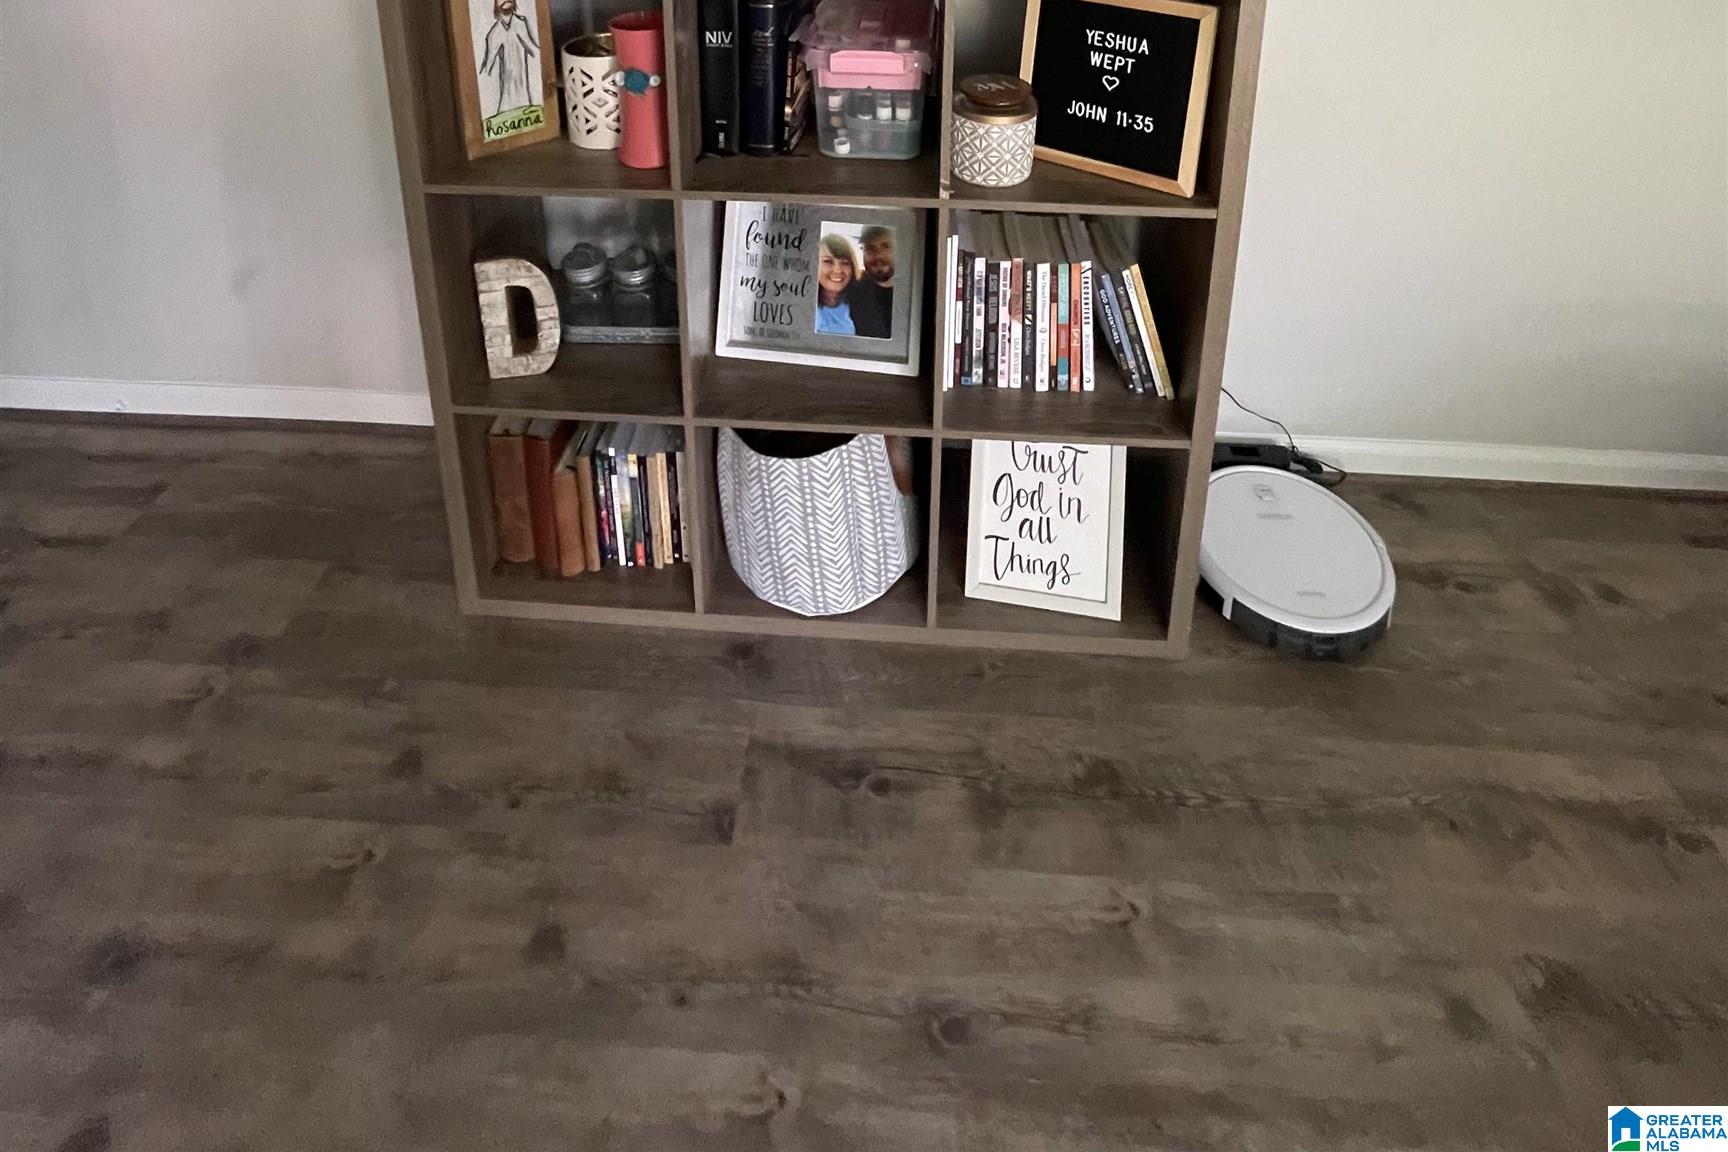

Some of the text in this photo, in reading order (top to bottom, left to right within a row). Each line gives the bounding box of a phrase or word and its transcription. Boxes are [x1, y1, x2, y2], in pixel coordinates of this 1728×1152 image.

[705, 31, 733, 44] NIV
[1086, 28, 1149, 55] YESHUA
[1090, 50, 1136, 74] WEPT
[1067, 100, 1107, 123] JOHN
[745, 219, 808, 252] found
[745, 252, 758, 268] THE
[740, 275, 812, 299] my soul
[474, 258, 560, 379] D
[753, 301, 793, 326] LOVES
[992, 473, 1089, 524] God in
[1018, 516, 1058, 545] all
[984, 534, 1081, 590] Things
